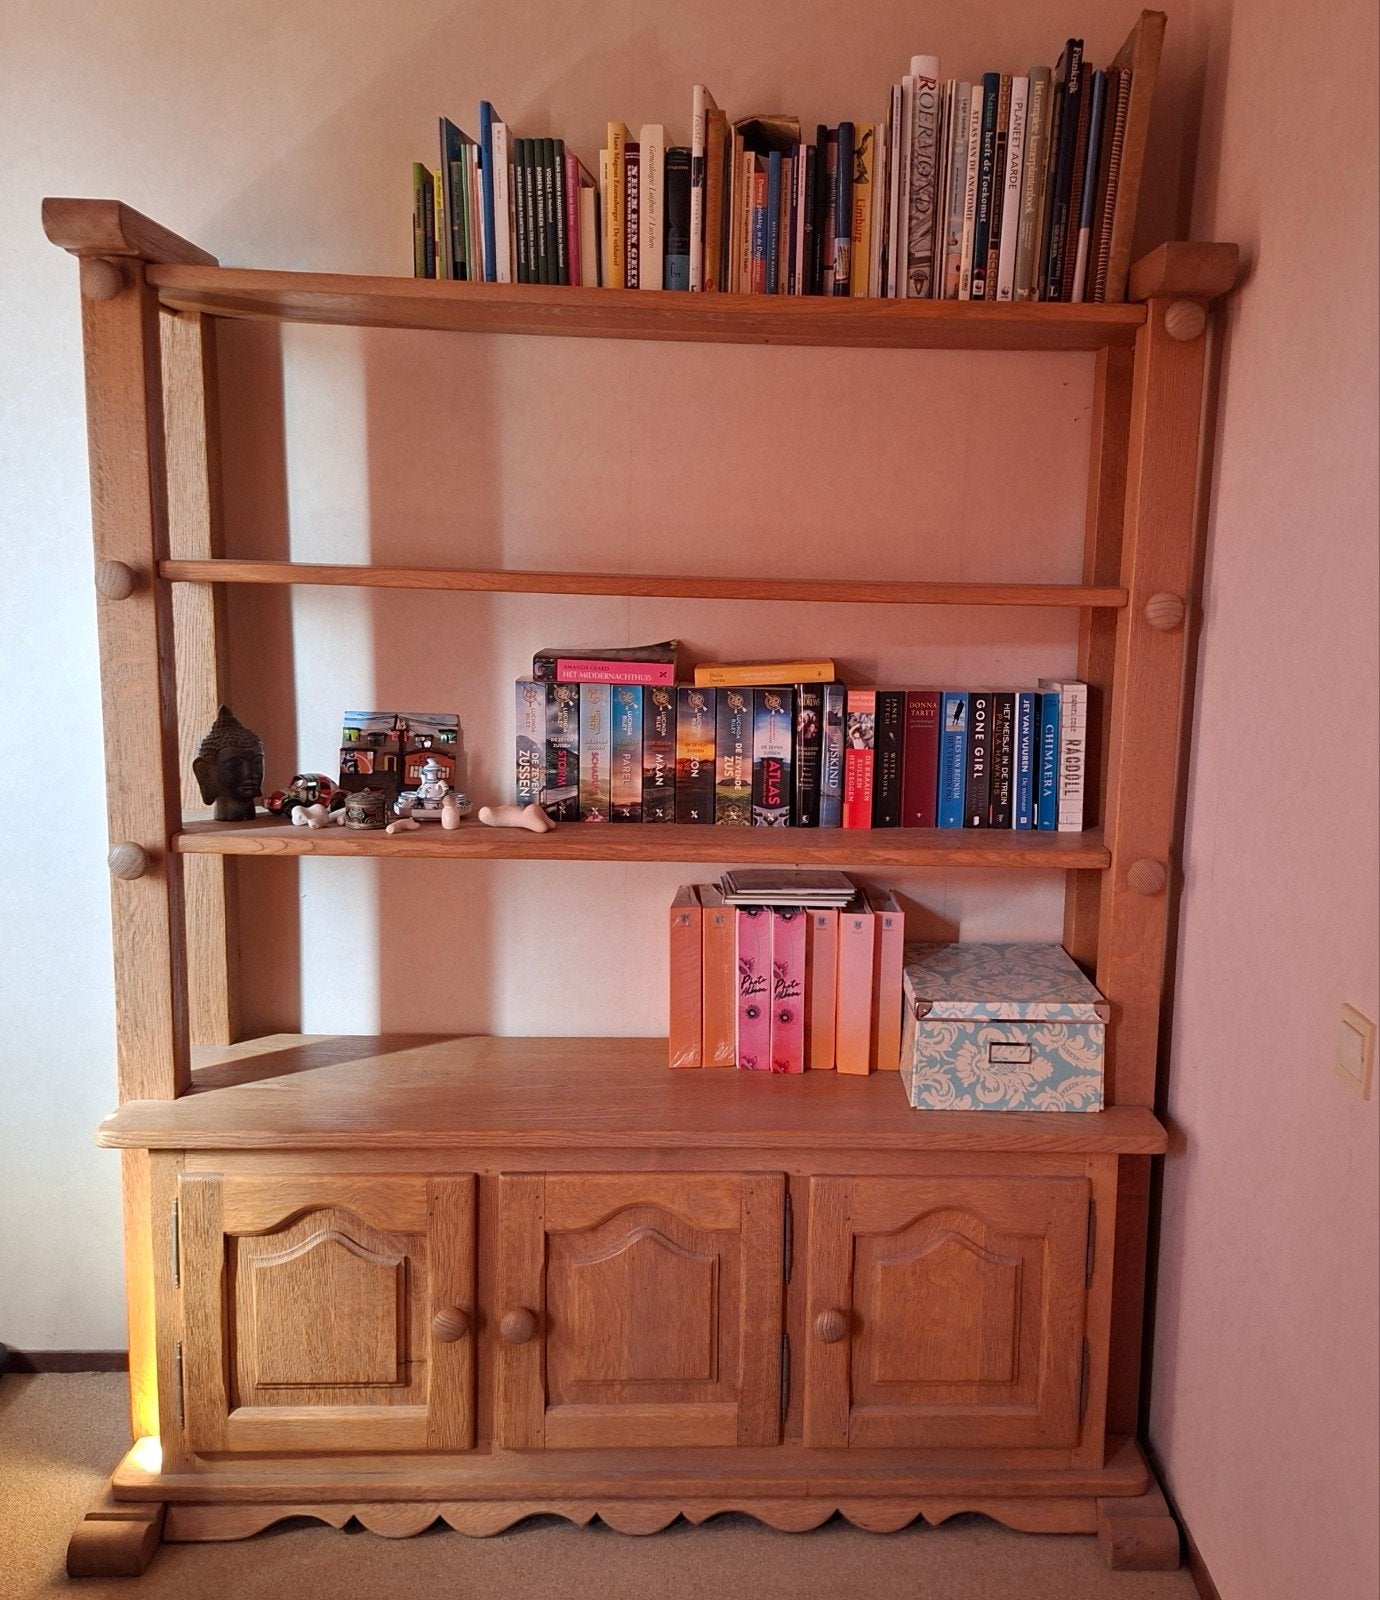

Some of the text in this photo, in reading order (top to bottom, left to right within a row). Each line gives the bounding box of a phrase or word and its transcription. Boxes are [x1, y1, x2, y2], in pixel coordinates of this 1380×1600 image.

[1069, 47, 1081, 94] Frankrijk
[1034, 80, 1044, 96] Het
[1029, 96, 1042, 134] complete
[915, 75, 937, 214] ROERMOND
[983, 131, 994, 156] heeft
[1008, 102, 1023, 191] PLANEET AARDE
[648, 145, 656, 185] Genealogie
[966, 109, 979, 222] ATLAS VAN DE ANATOMIE
[983, 159, 992, 172] de
[1025, 135, 1040, 214] kamerplantenboek
[612, 180, 620, 222] Enzensberger
[980, 174, 991, 222] Toekomst
[613, 227, 620, 237] De
[755, 205, 763, 228] gelukkig,
[852, 198, 865, 243] Limburg
[648, 222, 656, 249] Luyben
[755, 246, 763, 283] Dapperstraat
[580, 671, 652, 681] MIDDERNACHTHUIS
[735, 743, 742, 753] DE
[974, 699, 986, 778] GONE GIRL
[1021, 737, 1029, 772] VUUREN
[519, 750, 530, 797] ZUSSEN
[531, 753, 539, 794] DE ZEVEN
[557, 751, 567, 785] STORM
[591, 753, 599, 793] SCHADUW
[622, 753, 631, 784] PAREL
[655, 754, 663, 786] MAAN
[690, 756, 699, 777] ZON
[724, 756, 734, 777] ZUS
[829, 743, 839, 788] IJSKIND
[865, 755, 871, 766] DE
[993, 750, 1001, 795] HAWKINS
[1001, 767, 1008, 779] DE
[1002, 755, 1008, 764] IN
[1043, 724, 1054, 796] CHIMAERA
[1065, 739, 1081, 796] RAGDOLL
[768, 760, 781, 805] ATLAS
[1000, 781, 1008, 805] TREIN
[1022, 777, 1028, 786] De
[741, 974, 767, 989] Photo
[741, 986, 768, 997] Album
[774, 979, 801, 993] Photo
[774, 990, 801, 1001] Album
